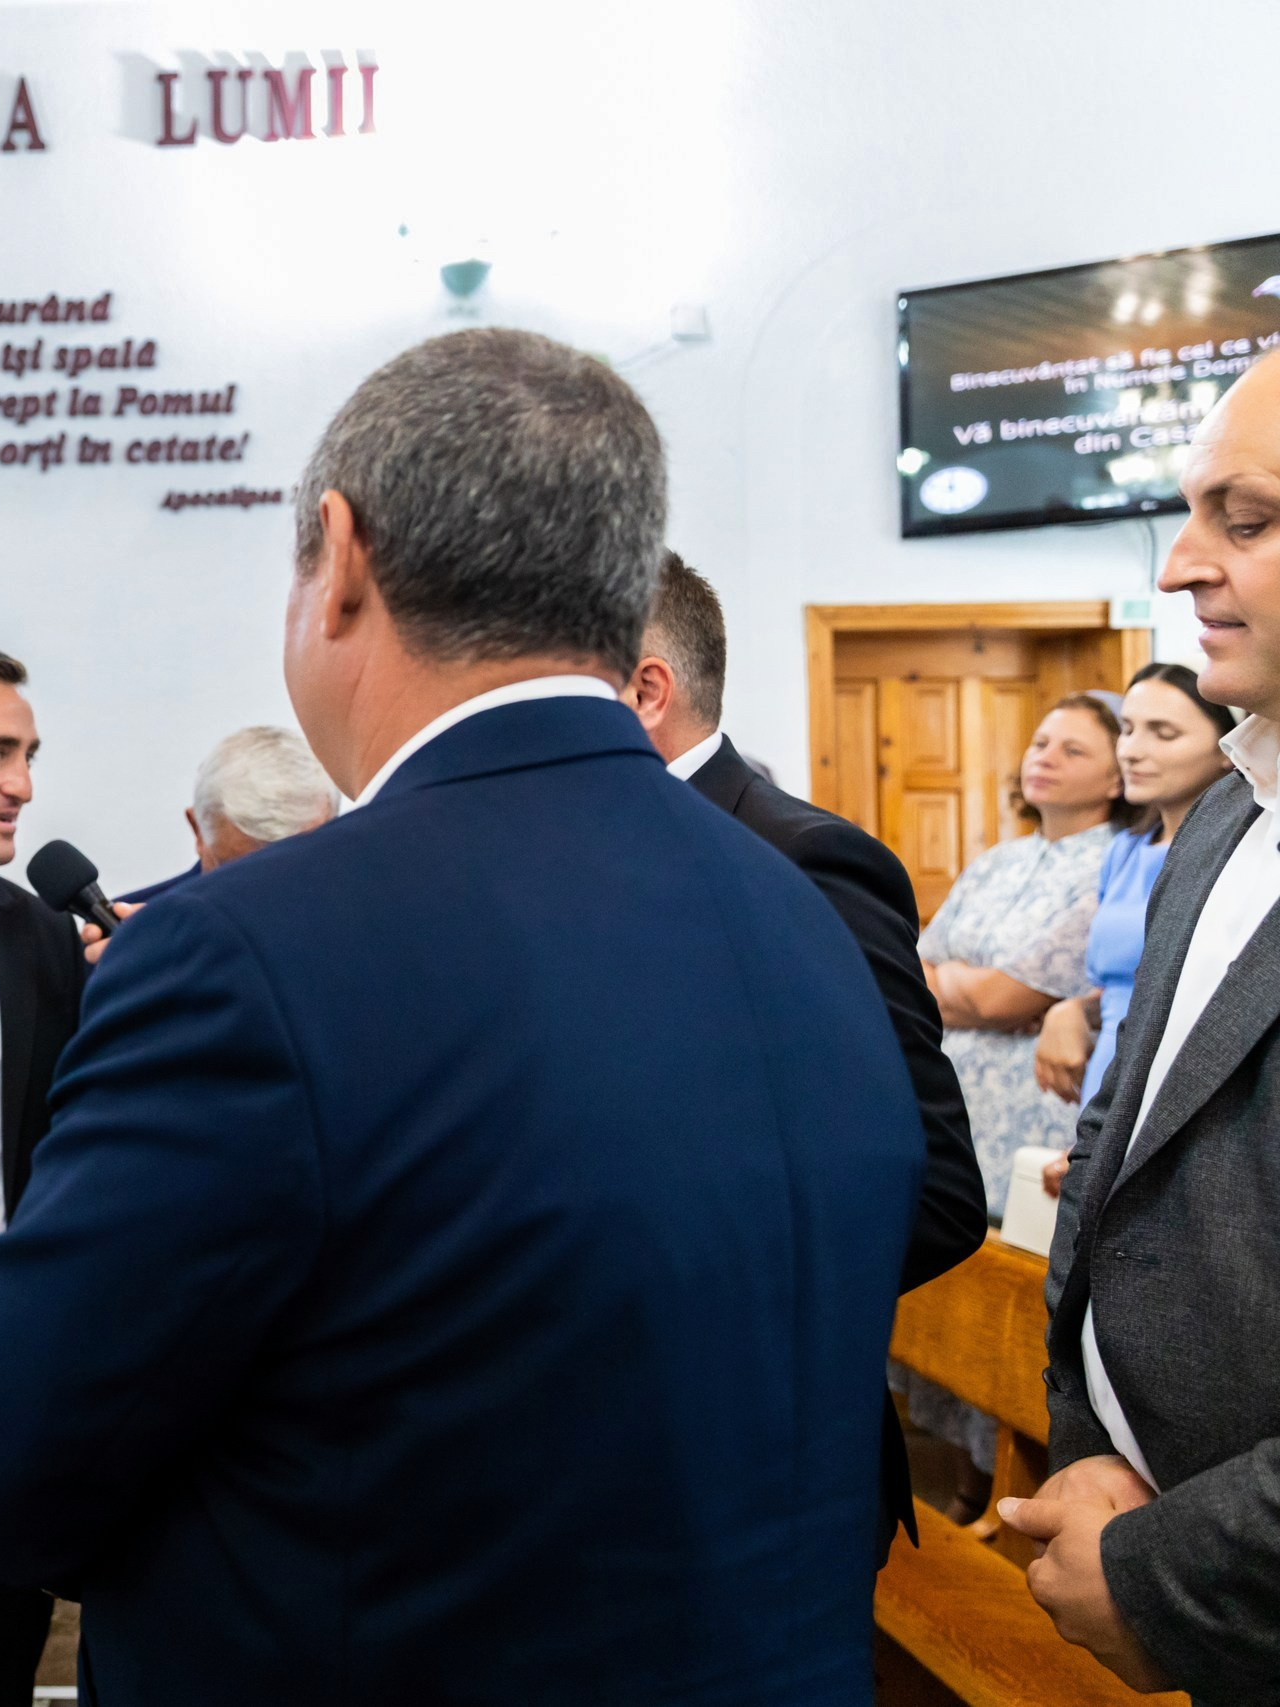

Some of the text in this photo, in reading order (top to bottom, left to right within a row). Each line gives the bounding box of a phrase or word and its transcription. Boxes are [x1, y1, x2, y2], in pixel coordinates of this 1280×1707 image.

[156, 64, 379, 145] LUMII
[55, 339, 158, 378] spală
[68, 386, 103, 417] la
[113, 384, 238, 417] Pomul
[125, 431, 250, 465] cetate!
